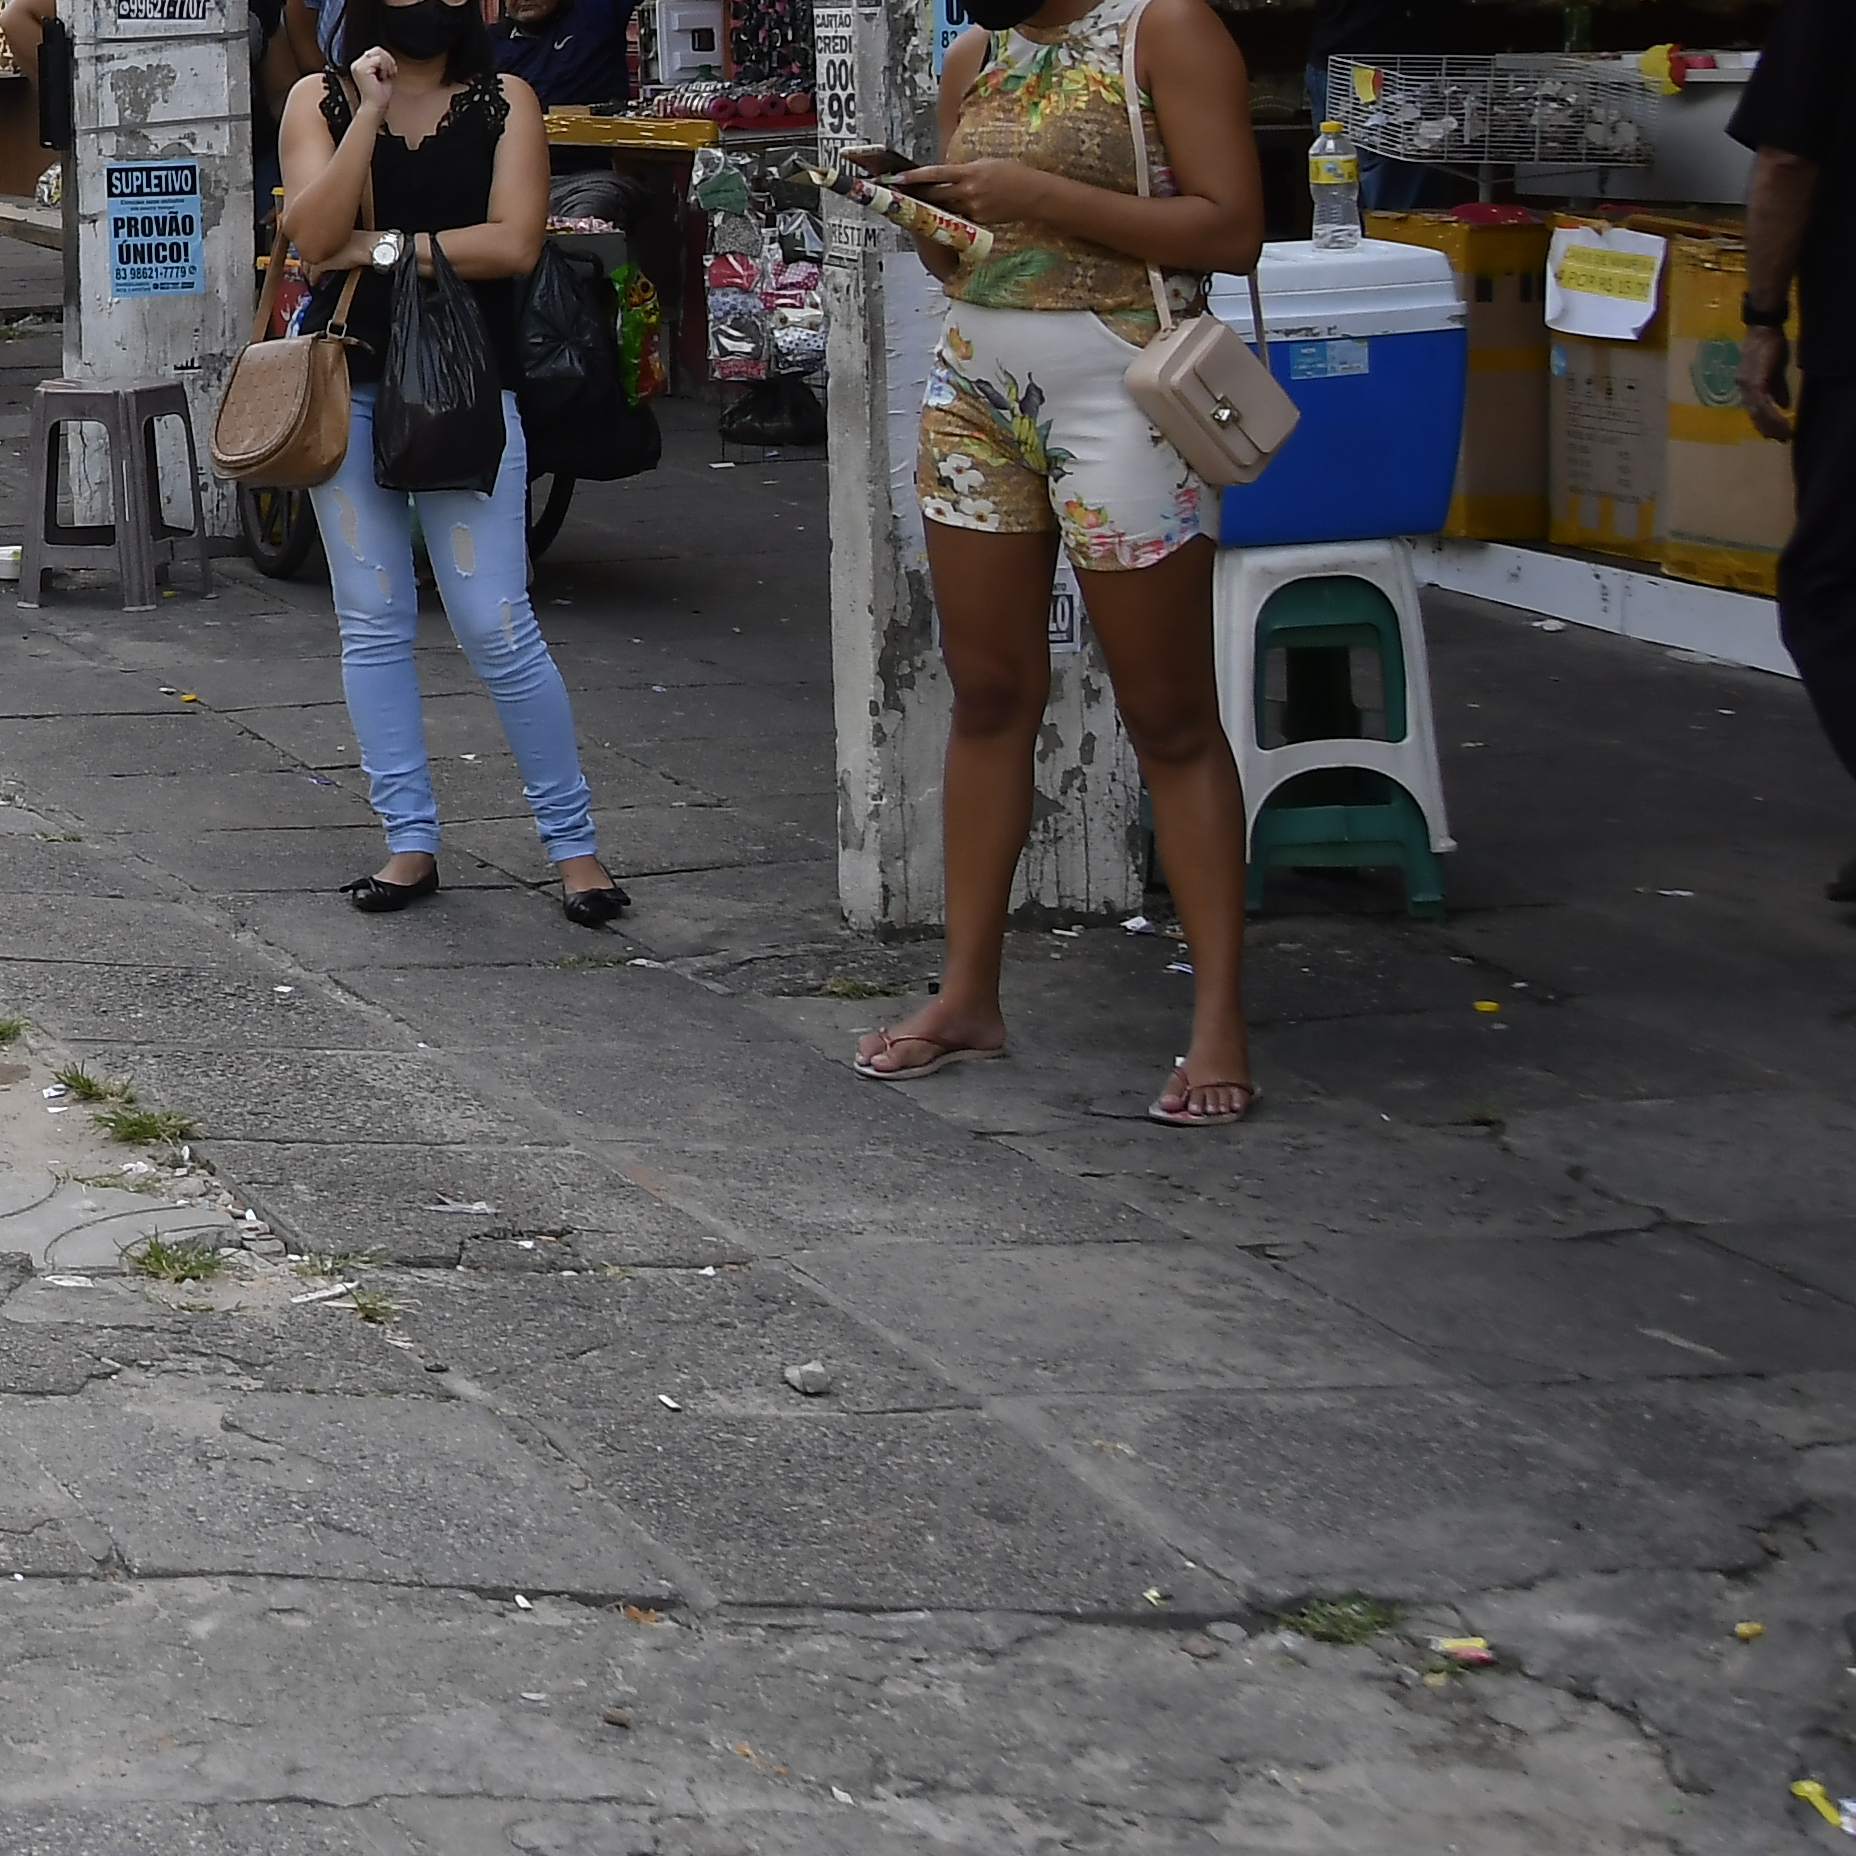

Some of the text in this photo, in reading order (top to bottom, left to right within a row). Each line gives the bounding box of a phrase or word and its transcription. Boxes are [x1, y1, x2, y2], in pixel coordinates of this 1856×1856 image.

[111, 169, 192, 194] SUPLETIVO
[113, 211, 195, 239] PROVÃO
[117, 240, 190, 265] ÚNICO!
[116, 268, 127, 280] 83
